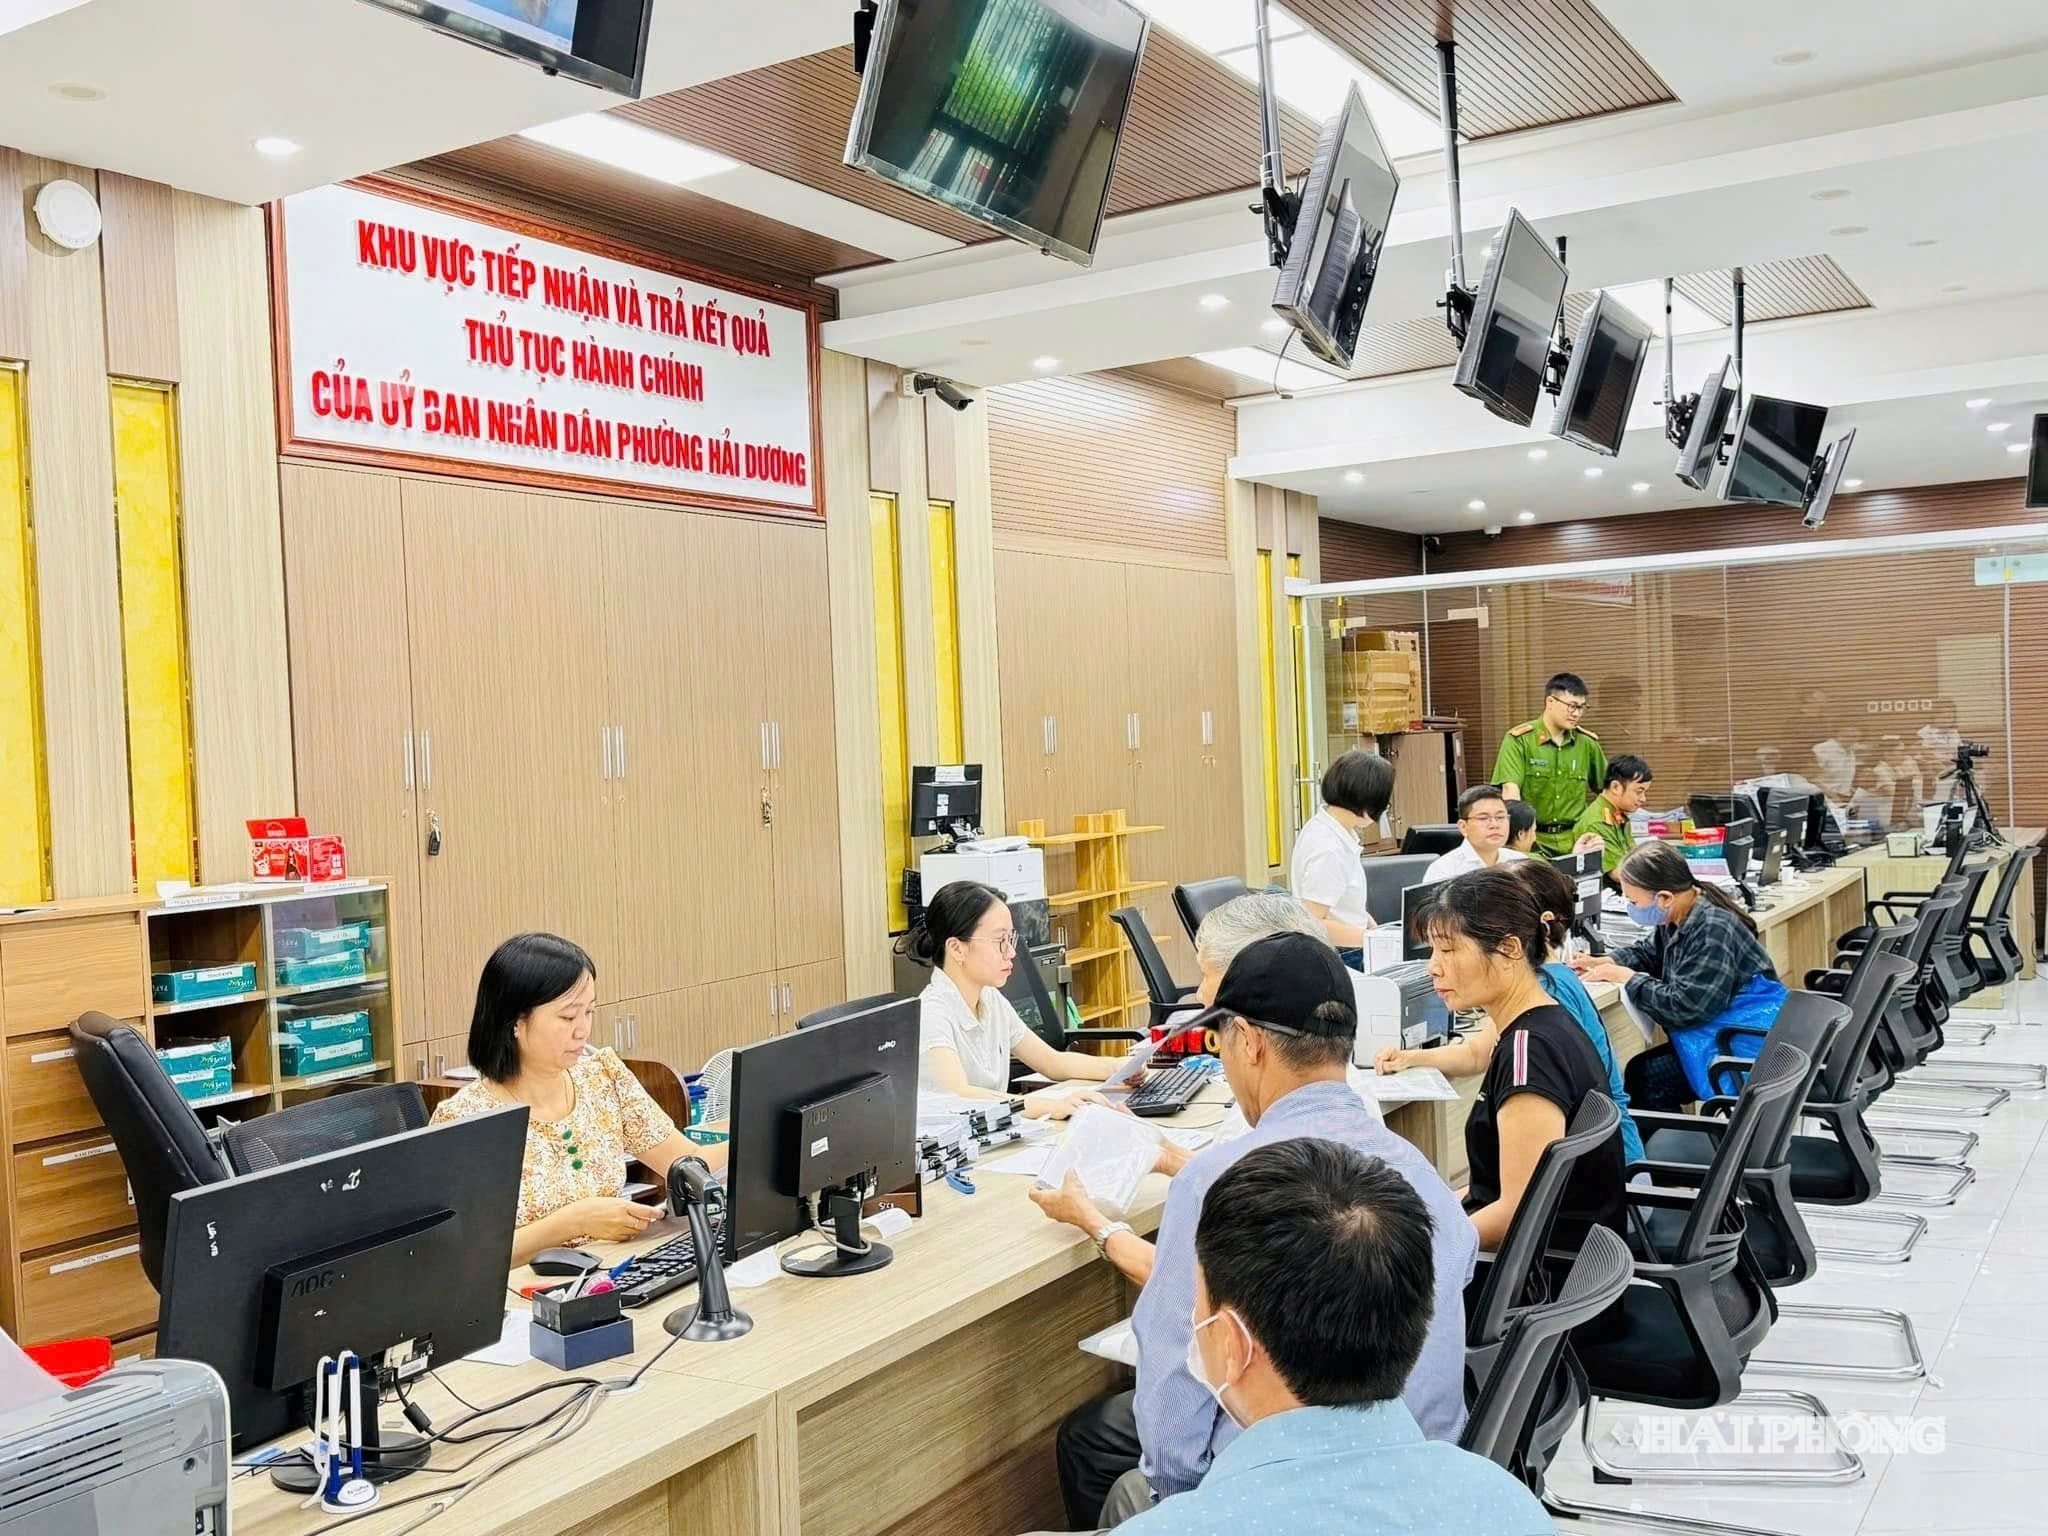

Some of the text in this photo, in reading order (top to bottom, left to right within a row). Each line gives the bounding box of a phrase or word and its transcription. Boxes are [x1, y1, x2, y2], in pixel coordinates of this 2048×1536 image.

[358, 220, 770, 356] KHU VỰC TIẾP NHẬN VÀ TRẢ KẾT QUẢ
[465, 310, 703, 401] THỦ TỤC HÀNH CHÍNH
[312, 358, 373, 422] CỦA
[424, 389, 480, 438] BAN
[487, 398, 558, 450] NHÂN
[564, 407, 612, 458] DÂN
[617, 418, 703, 472] PHƯỜNG
[708, 427, 740, 477] HẢI
[745, 444, 806, 486] DƯƠNG
